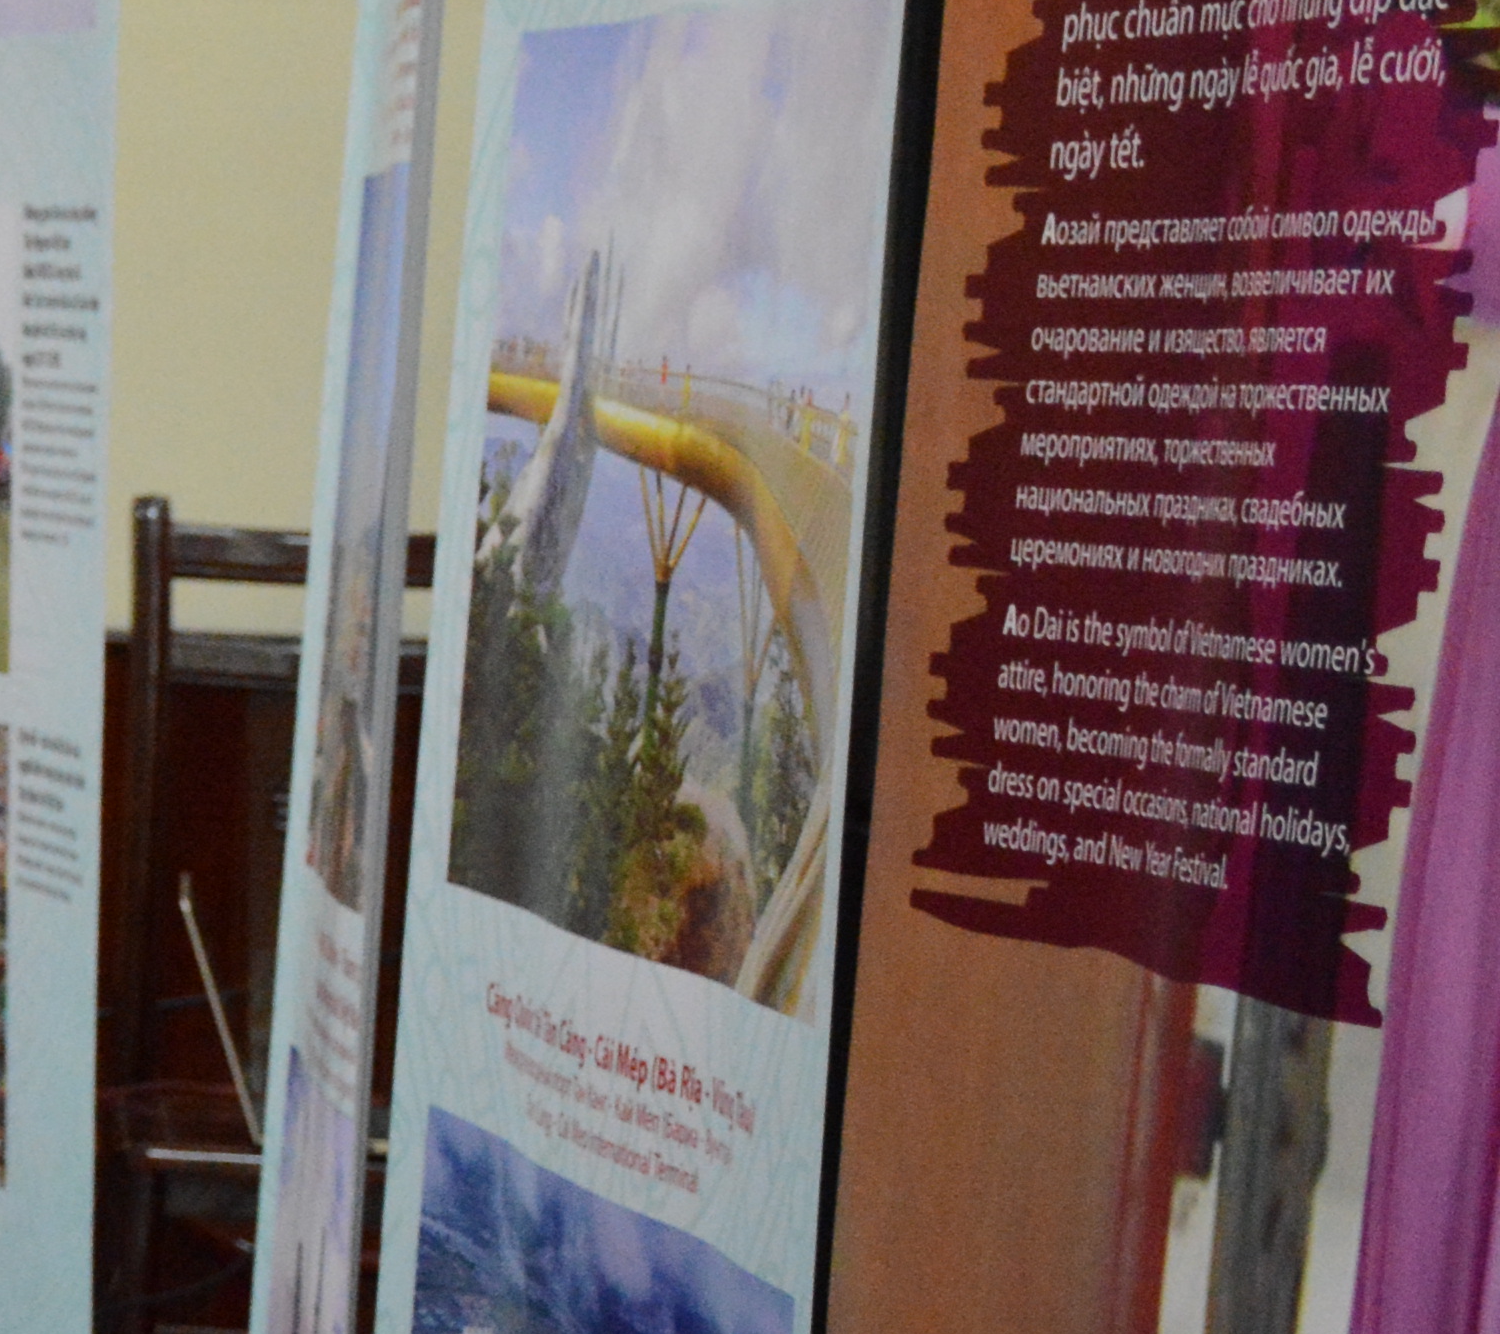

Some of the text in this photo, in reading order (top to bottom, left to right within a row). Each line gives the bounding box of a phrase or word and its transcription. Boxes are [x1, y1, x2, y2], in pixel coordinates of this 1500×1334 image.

[1061, 3, 1119, 52] phục
[1055, 65, 1106, 115] biệt,
[1110, 62, 1185, 112] những
[1189, 57, 1240, 111] ngày
[1305, 46, 1345, 99] gia,
[1349, 36, 1376, 85] lễ
[1380, 38, 1447, 88] cưới,
[1050, 124, 1146, 183] ngày tết.
[1041, 206, 1437, 252] Аозай представляет собой символ одежды
[1036, 268, 1396, 303] вьетнамских женщин, возвеличивает их
[1031, 325, 1328, 359] очарование и изящество, является
[1025, 375, 1145, 416] стандартной
[1147, 378, 1219, 415] одеждой
[1239, 382, 1391, 415] торжественных
[1019, 431, 1276, 471] мероприятиях, торжественных
[1015, 484, 1347, 529] национальных праздниках, свадебных
[1010, 536, 1344, 589] церемониях и новогодних праздниках.
[1002, 603, 1375, 676] Ao Dai is the symbol of Vietnamese women's
[997, 661, 1328, 730] attire, honoring the charm of Vietnamese
[993, 715, 1320, 787] women, becoming the formally standard
[987, 760, 1351, 858] dress on special occasions, national holidays,
[983, 817, 1230, 889] weddings, and New Year Festival.
